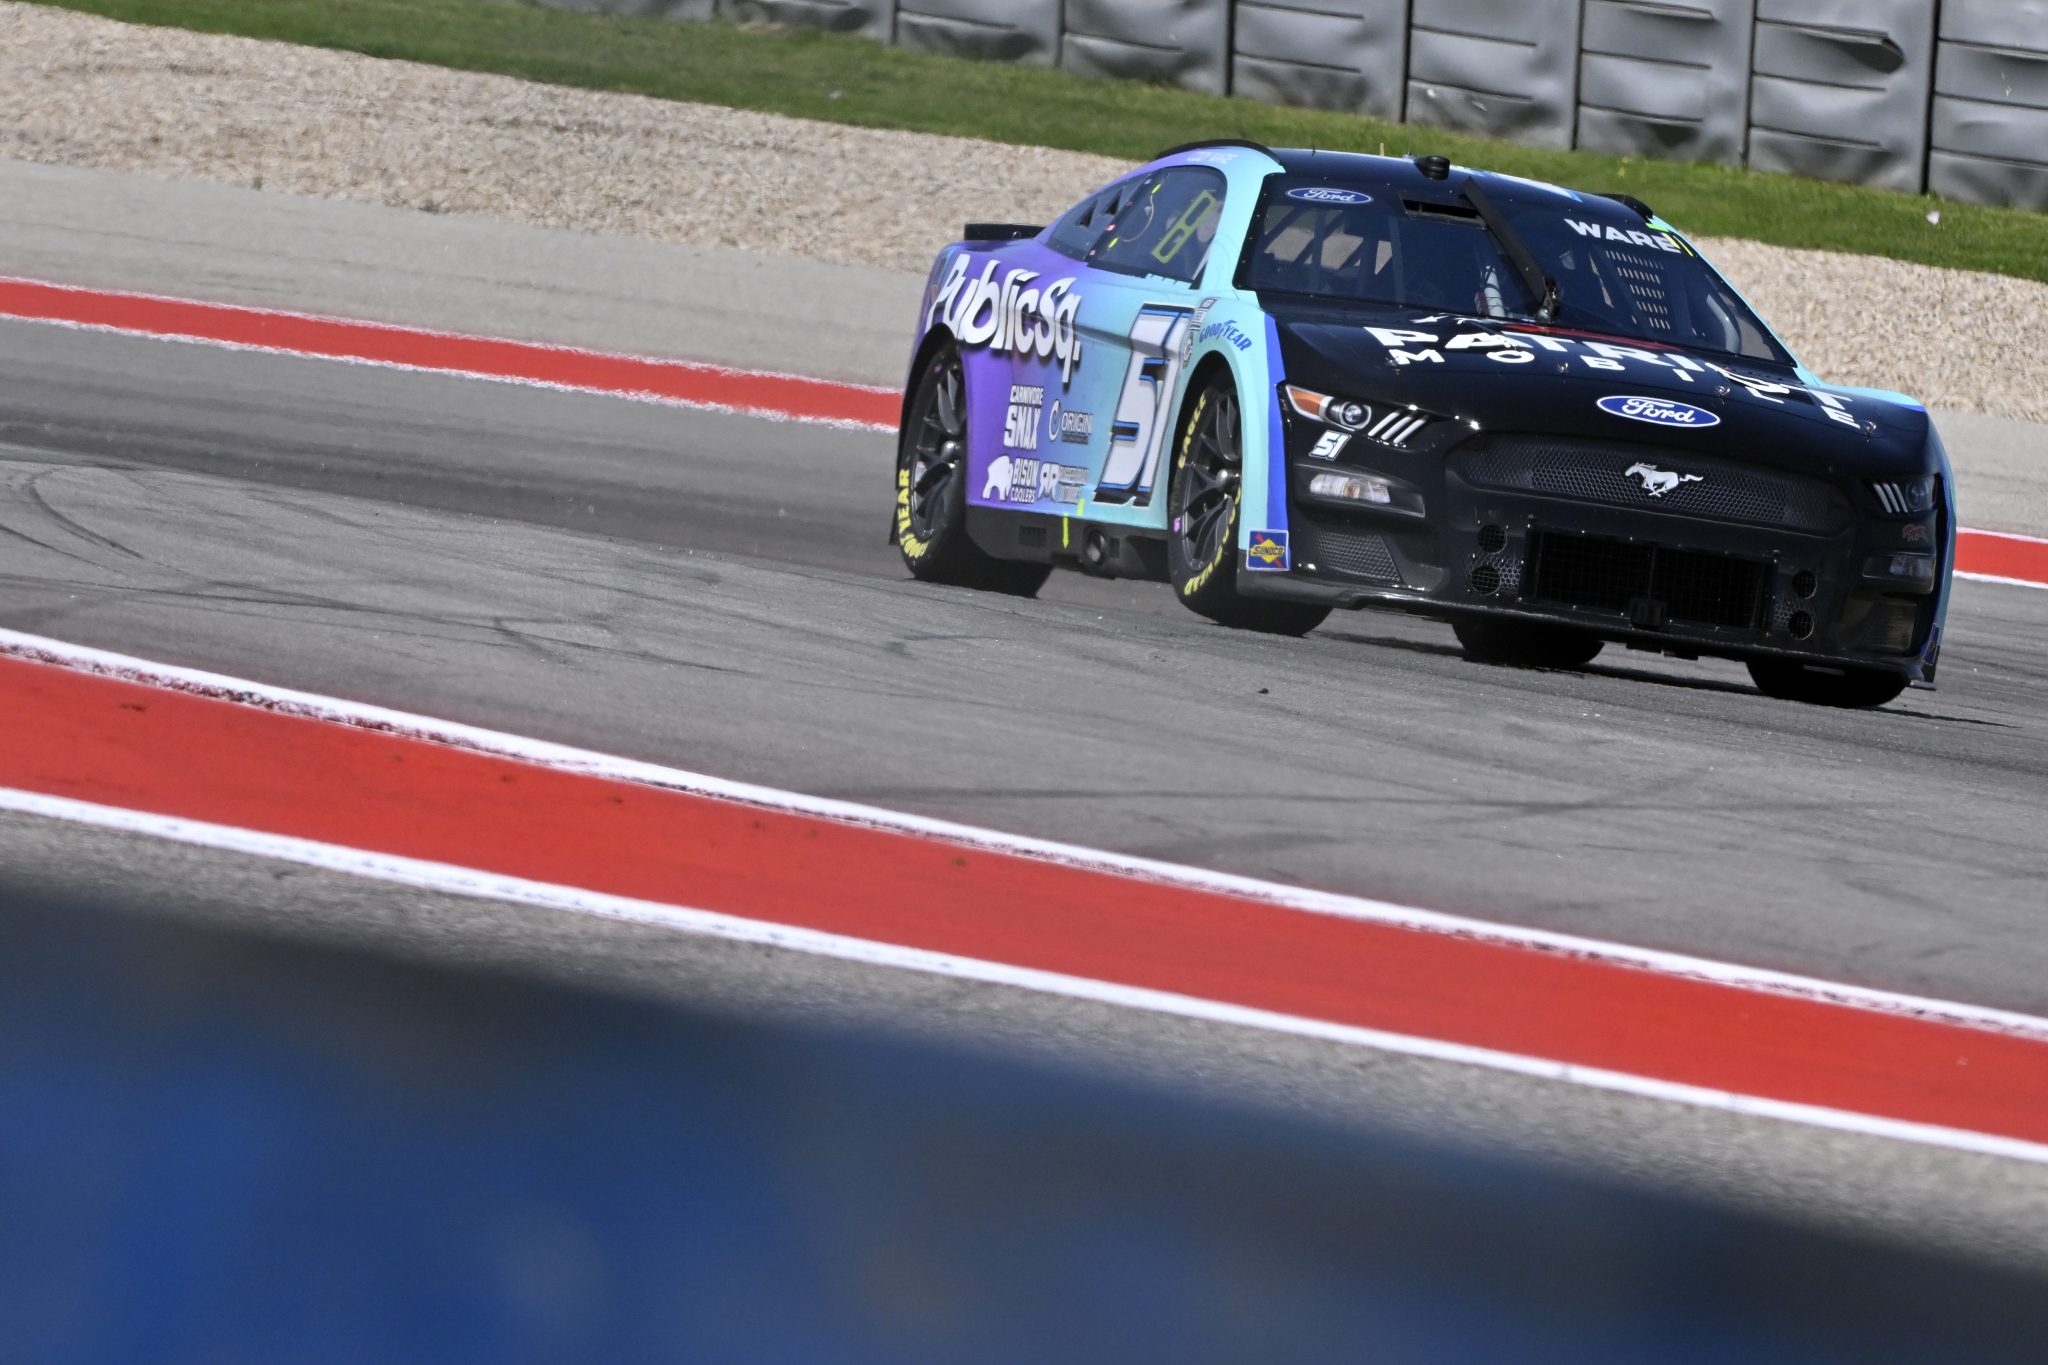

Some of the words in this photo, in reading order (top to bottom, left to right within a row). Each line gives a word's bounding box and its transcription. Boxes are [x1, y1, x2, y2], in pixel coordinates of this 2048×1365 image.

[1303, 186, 1355, 203] Ford
[1563, 218, 1682, 254] WARE
[925, 254, 1082, 384] PublicSq.
[1199, 319, 1252, 351] GOODYEAR
[1363, 326, 1854, 408] PATRIOT
[1010, 384, 1044, 405] CARNIVORE
[1094, 304, 1194, 507] 51
[1397, 350, 1862, 430] MOBILE
[1625, 397, 1696, 424] Ford
[1003, 404, 1042, 450] SNAX
[1309, 430, 1352, 460] 51
[1013, 457, 1040, 487] BISON
[1010, 487, 1036, 503] COOLERS
[1252, 544, 1285, 557] SUNOCO
